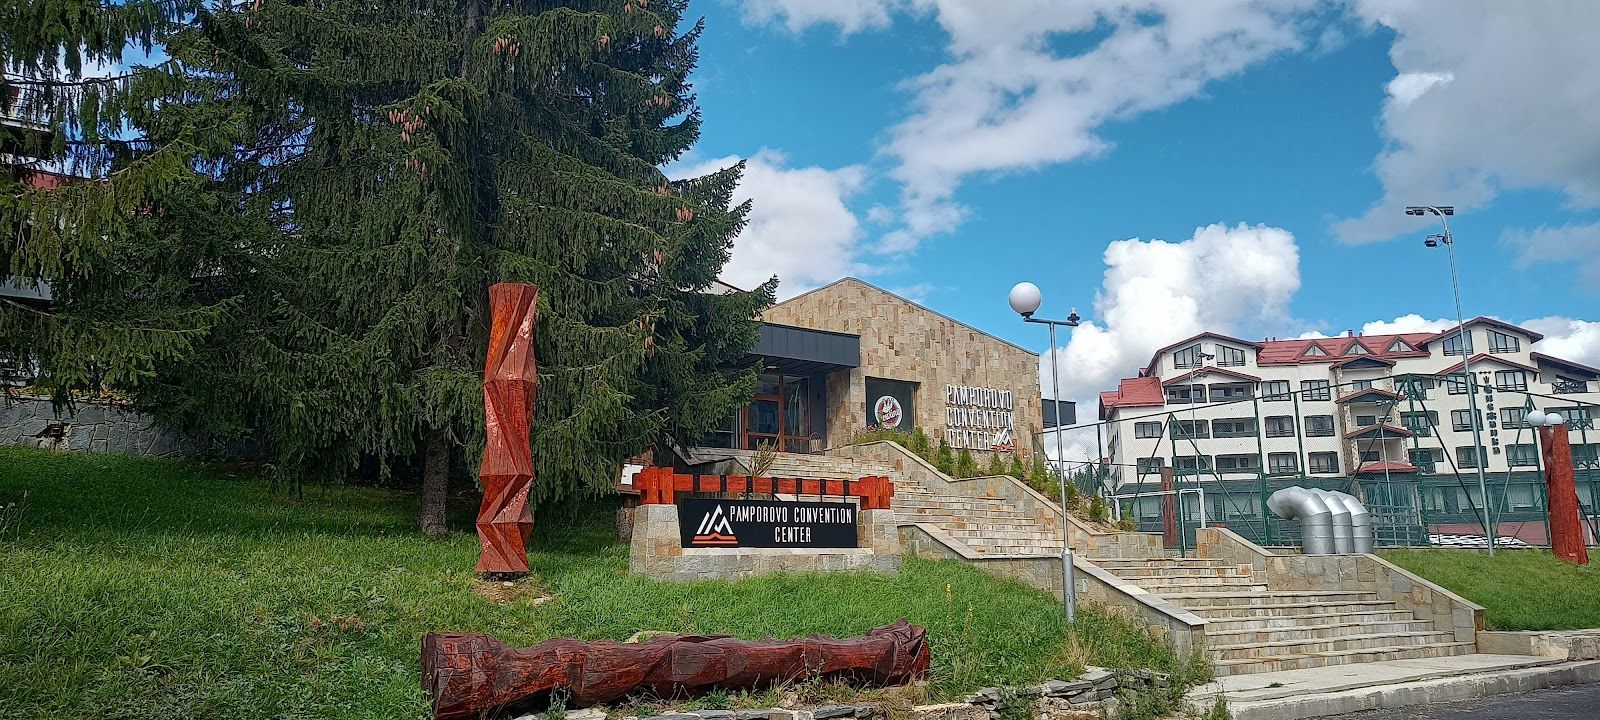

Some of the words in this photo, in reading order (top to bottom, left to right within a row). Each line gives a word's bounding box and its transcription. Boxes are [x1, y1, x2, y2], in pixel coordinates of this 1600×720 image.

[946, 384, 1013, 410] PAMPOROVO
[945, 407, 1014, 431] CONVENTION
[947, 429, 990, 450] CENTER
[730, 505, 788, 523] PAMPOROVO
[794, 506, 852, 524] CONVENTION
[774, 526, 811, 543] CENTER
